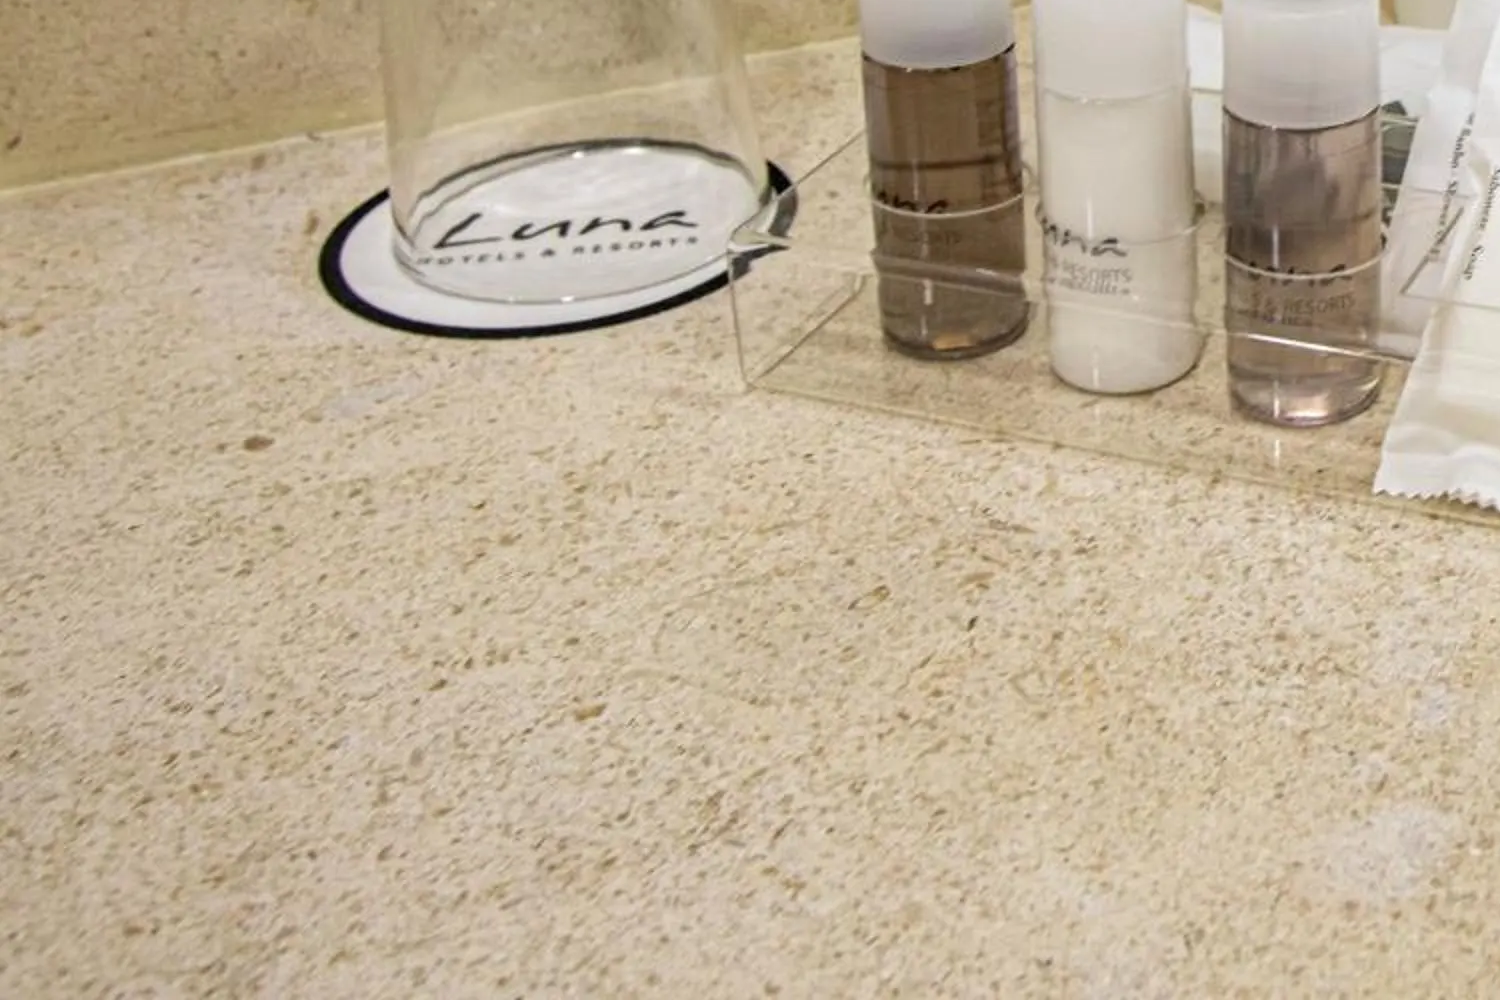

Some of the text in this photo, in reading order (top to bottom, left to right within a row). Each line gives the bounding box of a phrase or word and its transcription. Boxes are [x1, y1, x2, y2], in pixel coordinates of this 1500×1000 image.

[434, 209, 700, 250] Luna
[1041, 216, 1130, 257] una
[415, 249, 527, 267] HOTELS
[572, 235, 700, 256] RESORTS
